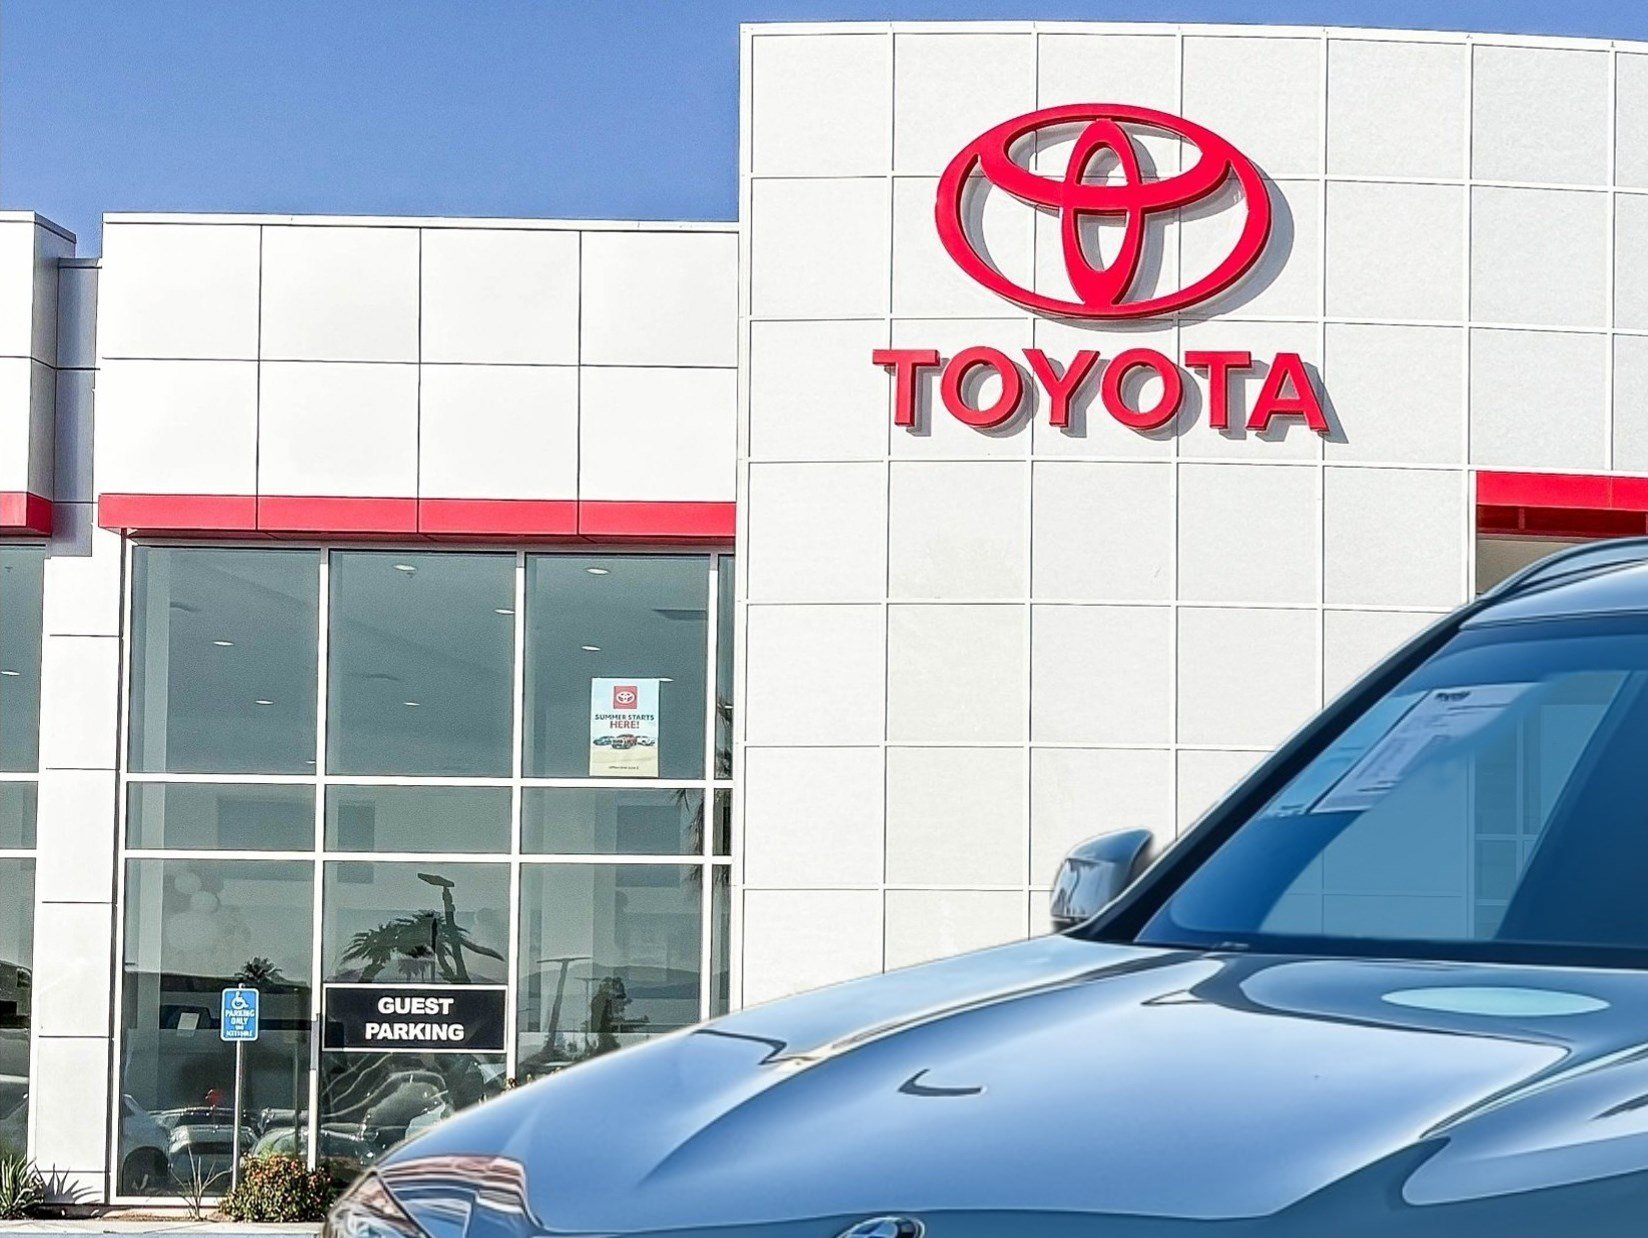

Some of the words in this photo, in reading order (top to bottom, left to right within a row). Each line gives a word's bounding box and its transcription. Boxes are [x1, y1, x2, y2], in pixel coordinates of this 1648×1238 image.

[872, 346, 1330, 433] TOYOTA
[610, 721, 640, 729] HERE!
[377, 997, 454, 1015] GUEST
[365, 1022, 465, 1041] PARKING
